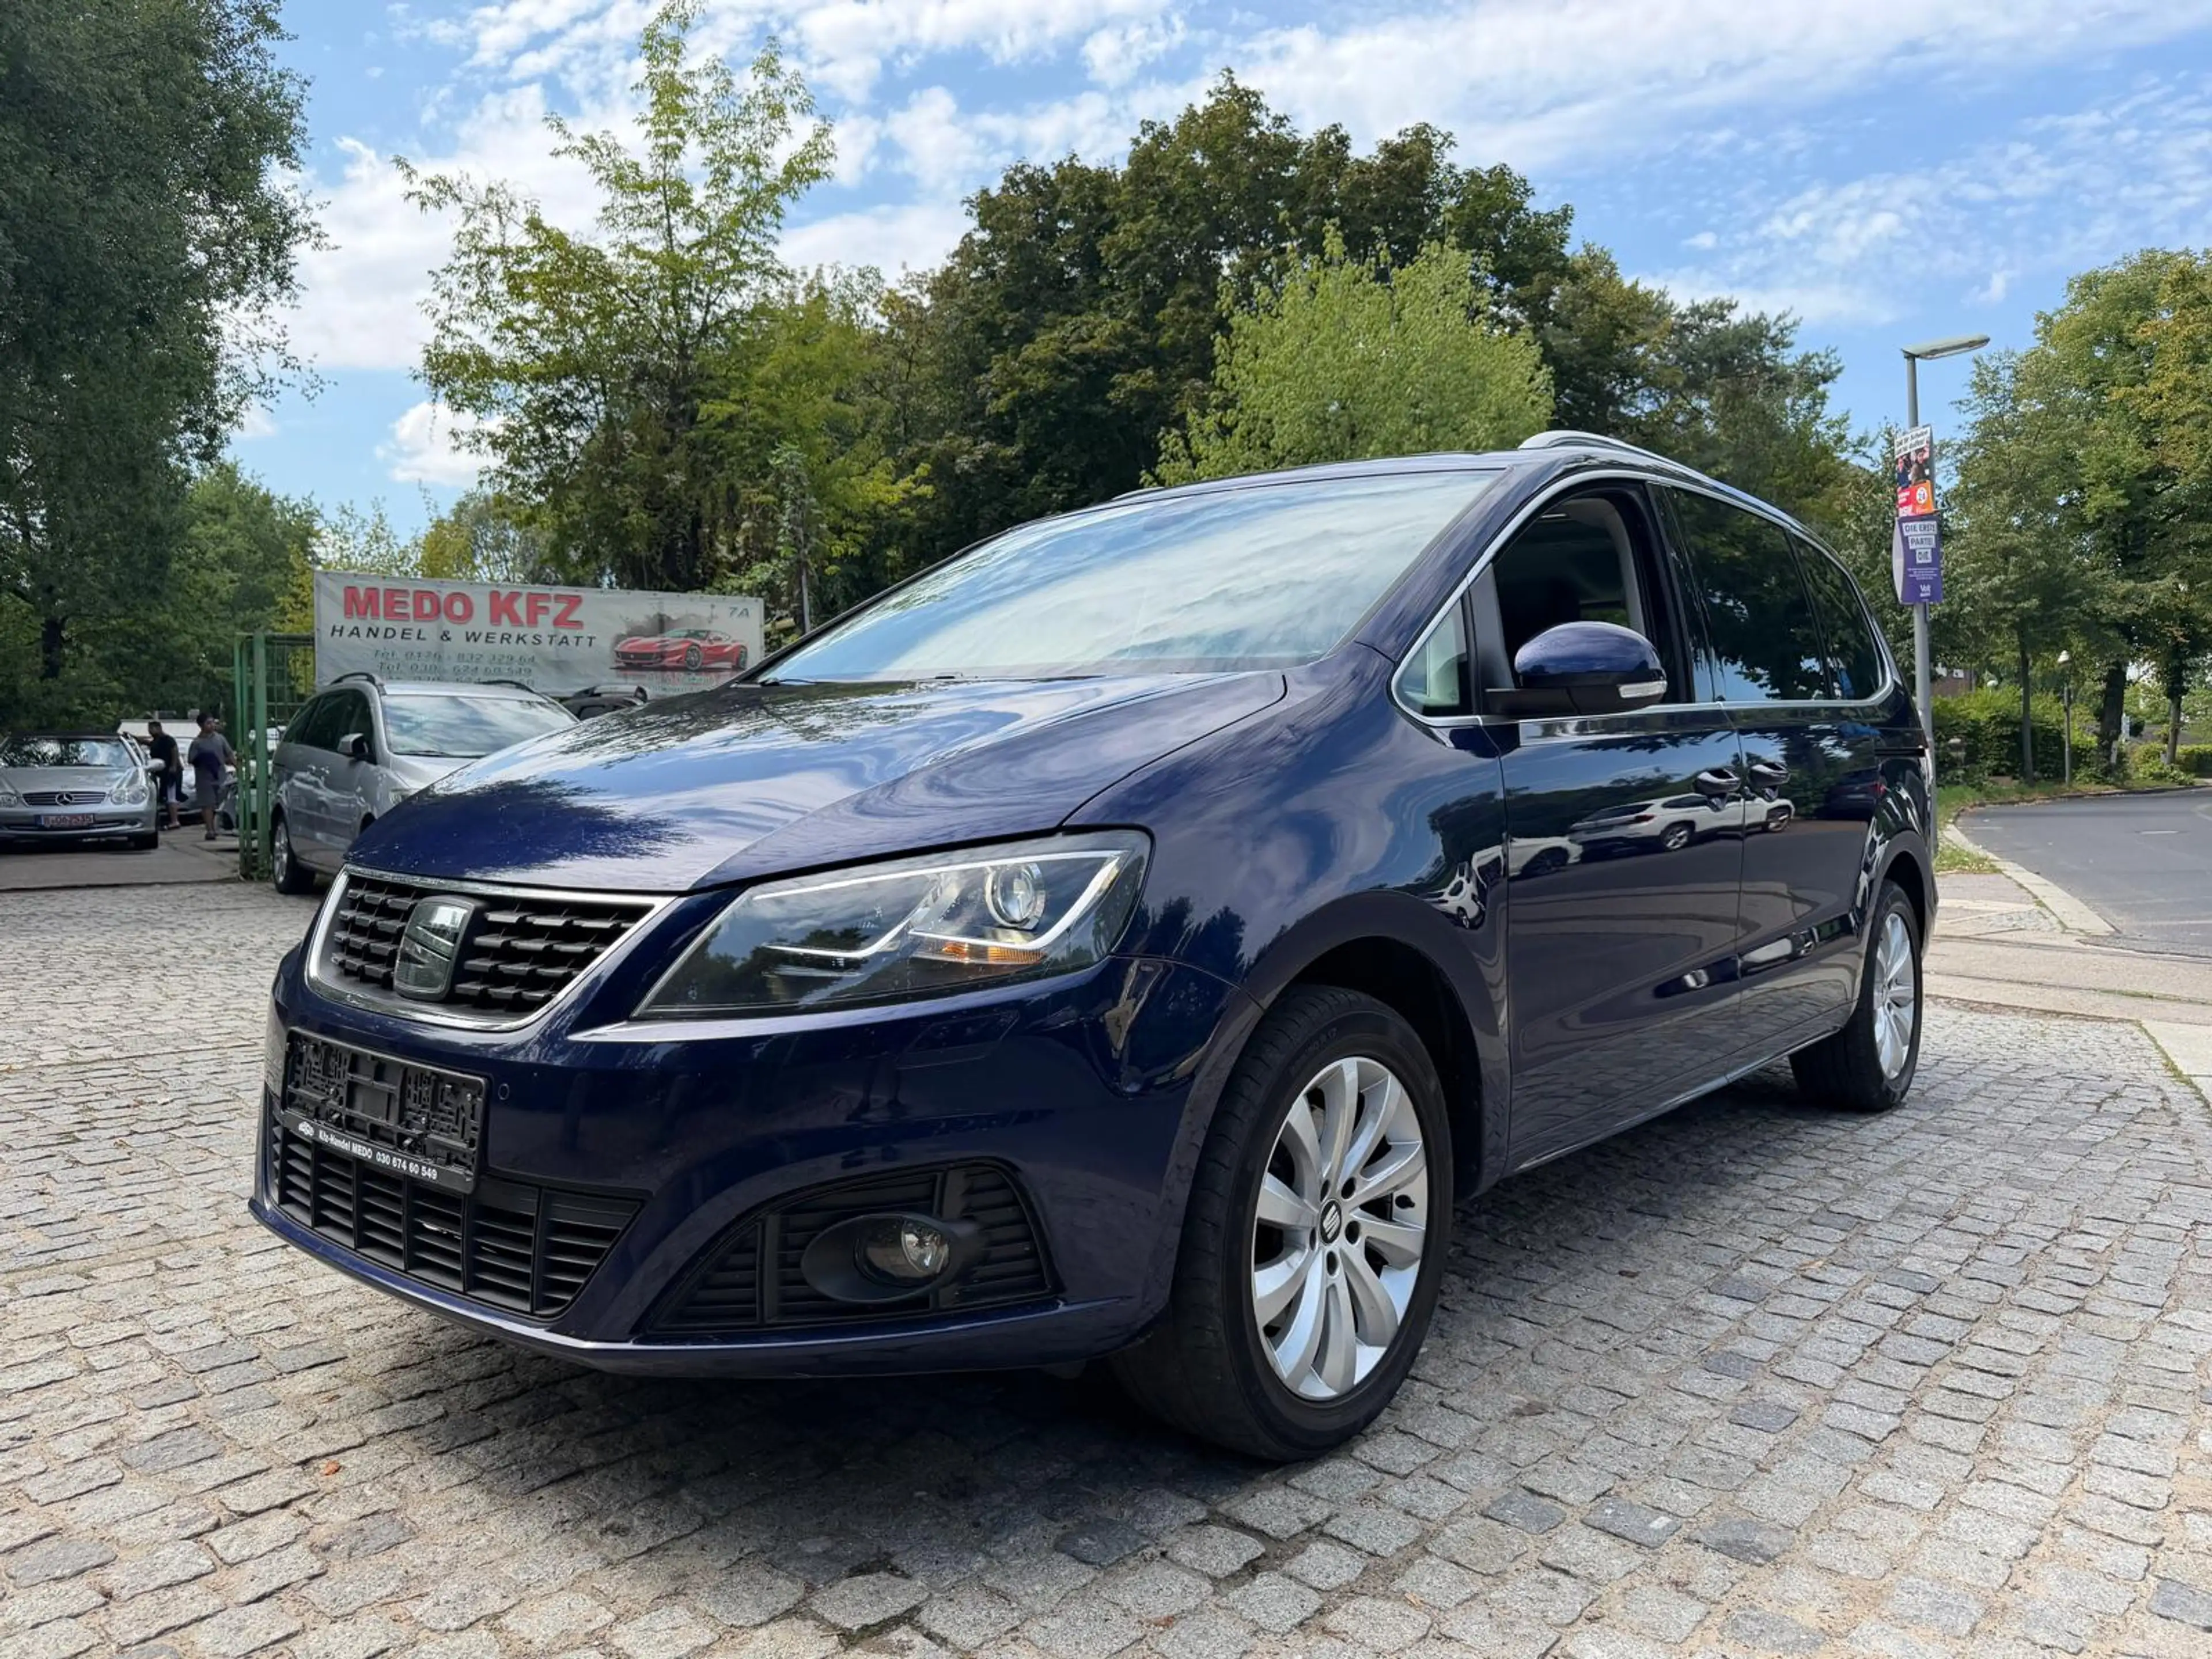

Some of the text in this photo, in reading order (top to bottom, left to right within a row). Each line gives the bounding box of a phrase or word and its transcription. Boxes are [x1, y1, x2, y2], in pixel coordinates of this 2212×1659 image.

[1920, 584, 1931, 593] Volt
[344, 586, 584, 629] MEDO KFZ
[728, 607, 749, 618] 7A
[330, 624, 597, 647] HANDEL & WERKSTATT
[352, 1141, 373, 1159] MEDO
[376, 1152, 391, 1165] 030
[392, 1156, 407, 1171] 674
[408, 1162, 420, 1175] 60
[421, 1167, 438, 1180] 549
